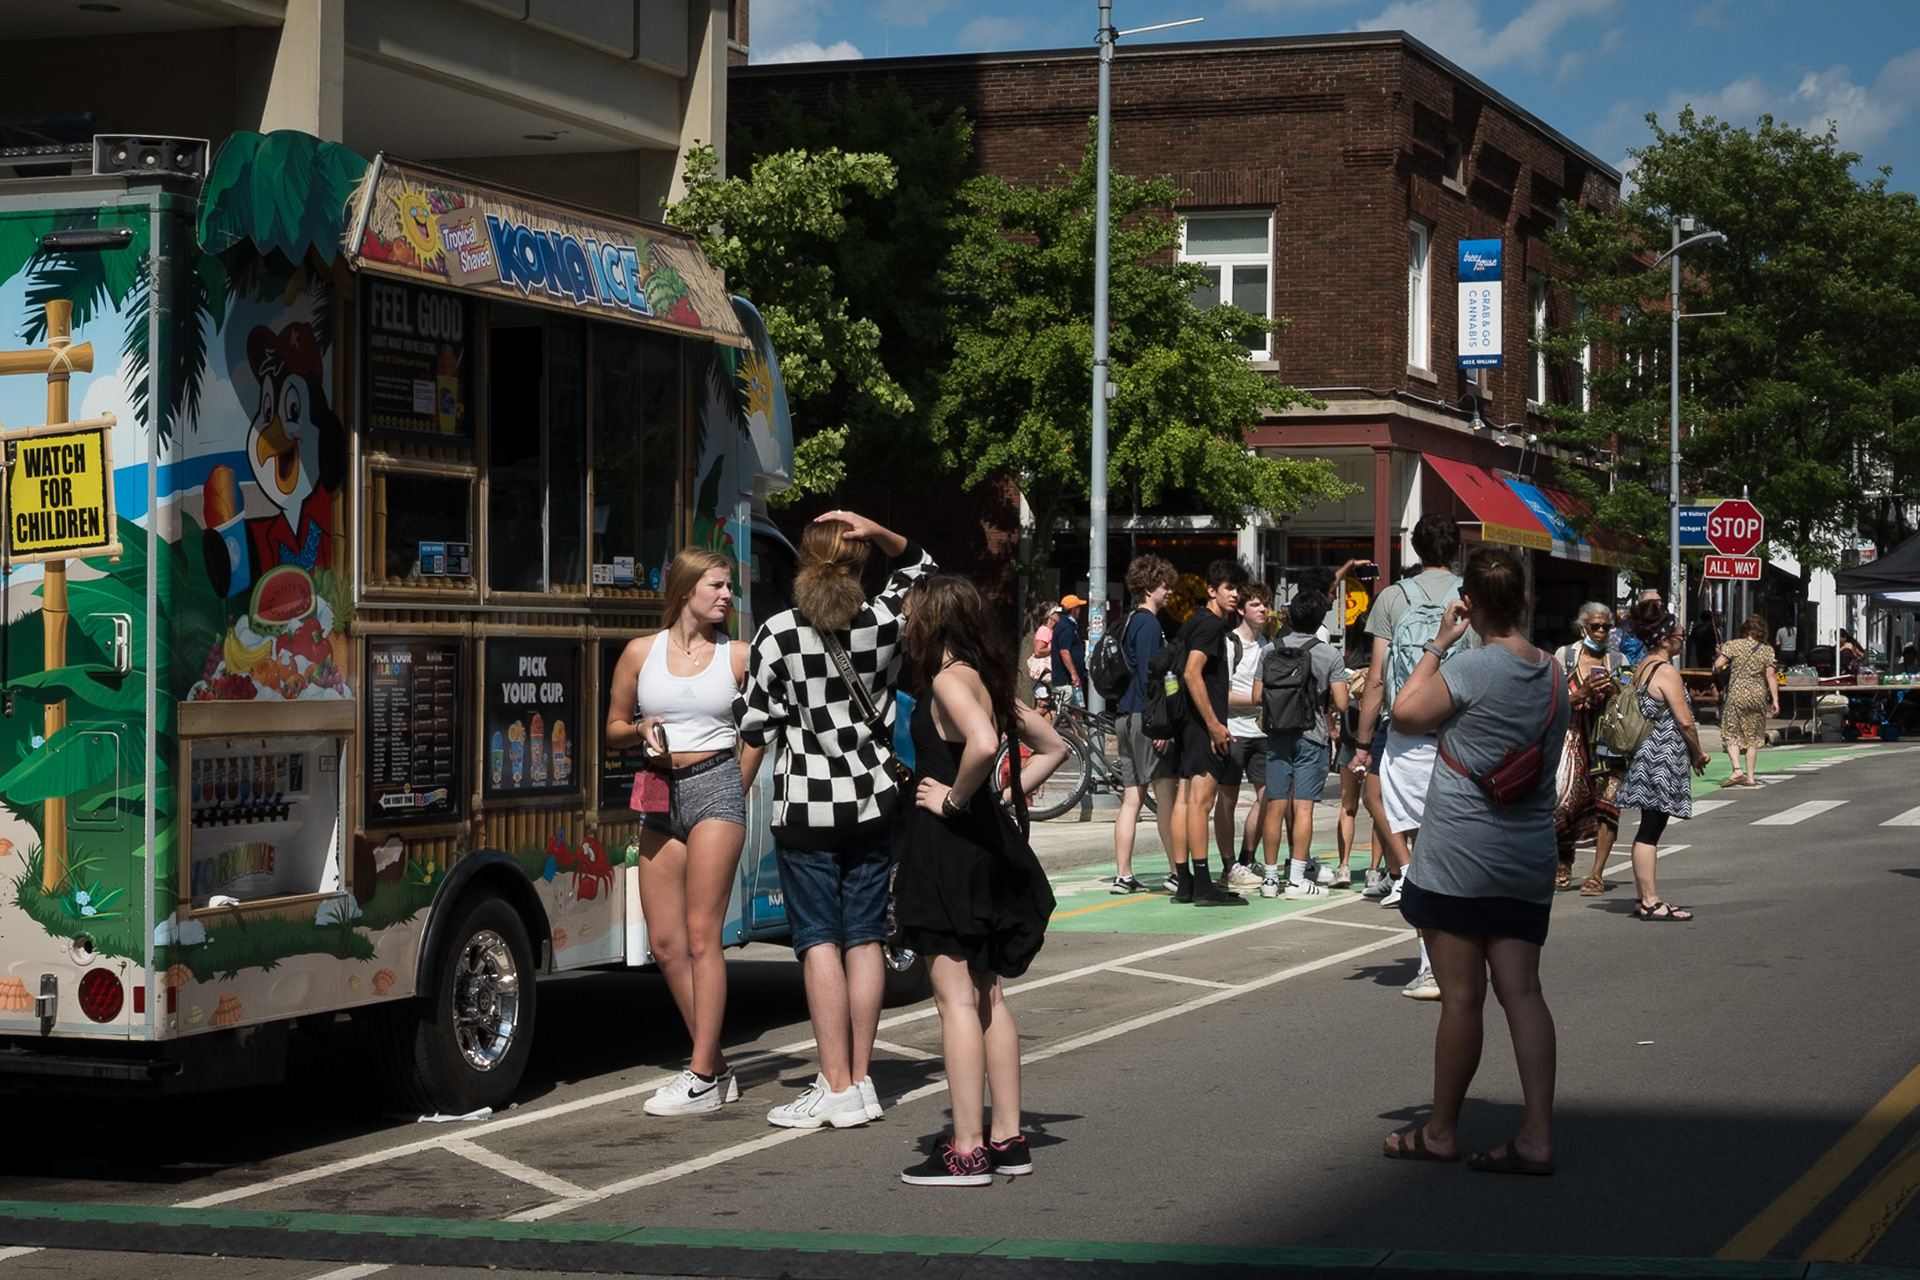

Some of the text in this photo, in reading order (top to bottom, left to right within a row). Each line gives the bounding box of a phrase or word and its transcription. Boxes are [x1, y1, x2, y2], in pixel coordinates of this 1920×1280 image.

[442, 219, 478, 254] Tropical
[459, 247, 492, 274] Shaved
[486, 214, 653, 316] KONA ICE
[371, 282, 464, 342] FEEL GOOD
[1482, 289, 1491, 319] GRAB
[1468, 289, 1478, 348] CANNABIS
[1482, 330, 1491, 347] GO
[22, 443, 86, 479] WATCH
[39, 477, 73, 510] FOR
[15, 506, 100, 544] CHILDREN
[1710, 517, 1760, 538] STOP
[1709, 561, 1756, 575] ALL WAY
[372, 651, 390, 664] PICK
[391, 651, 412, 664] YOUR
[518, 656, 547, 677] PICK
[502, 682, 564, 704] YOUR CUP.
[691, 757, 715, 774] NIKE
